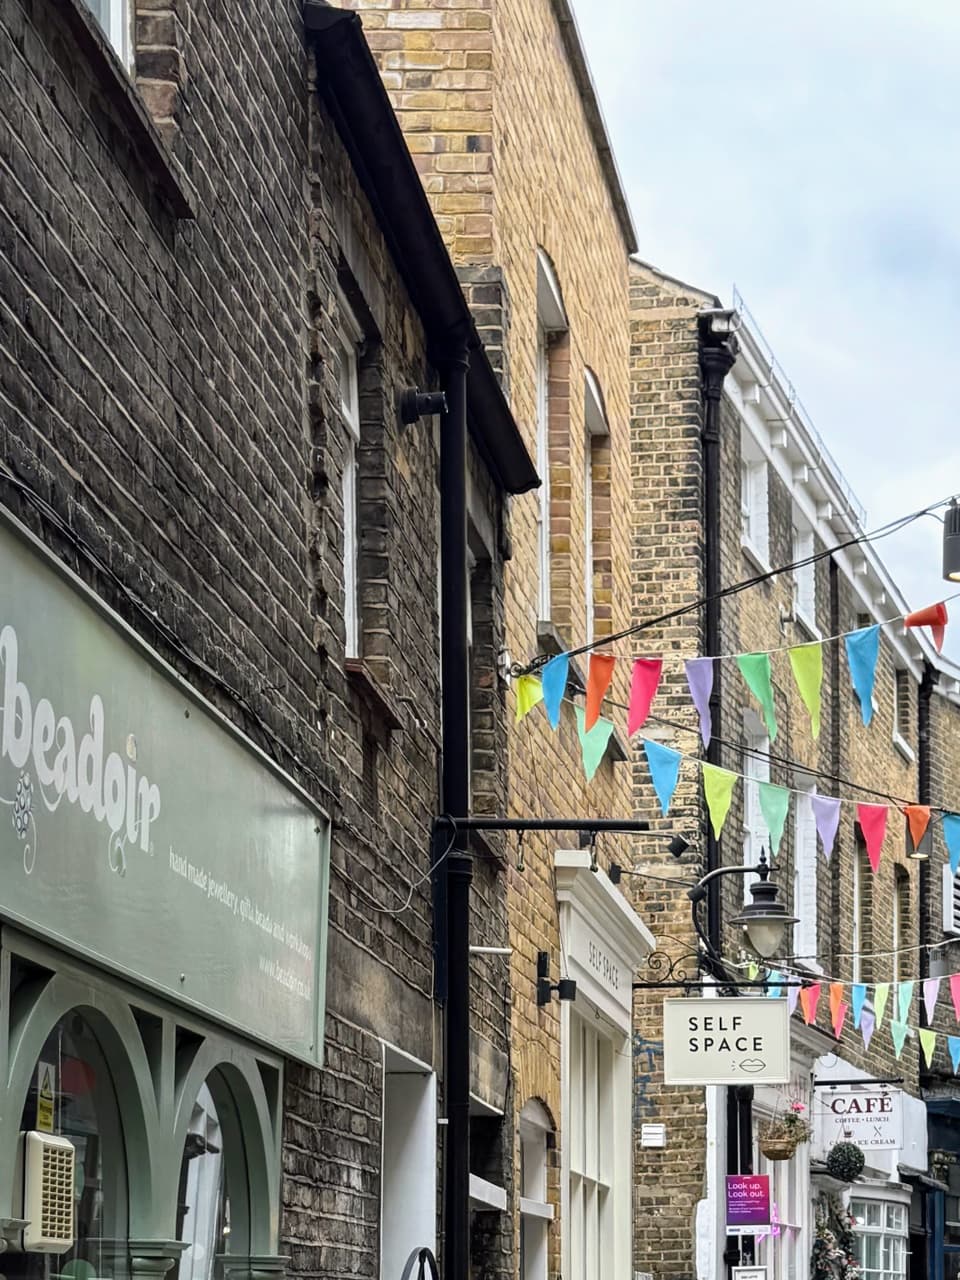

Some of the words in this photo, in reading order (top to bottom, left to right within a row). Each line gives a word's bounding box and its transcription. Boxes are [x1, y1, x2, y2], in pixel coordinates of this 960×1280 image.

[0, 625, 160, 853] beadoir
[169, 845, 188, 878] hand
[188, 862, 207, 890] made
[589, 940, 601, 972] SELF
[603, 955, 618, 991] SPACE
[688, 1016, 742, 1032] SELF
[688, 1036, 763, 1053] SPACE
[728, 1182, 748, 1190] Look
[749, 1182, 762, 1191] up.
[728, 1190, 748, 1198] Look
